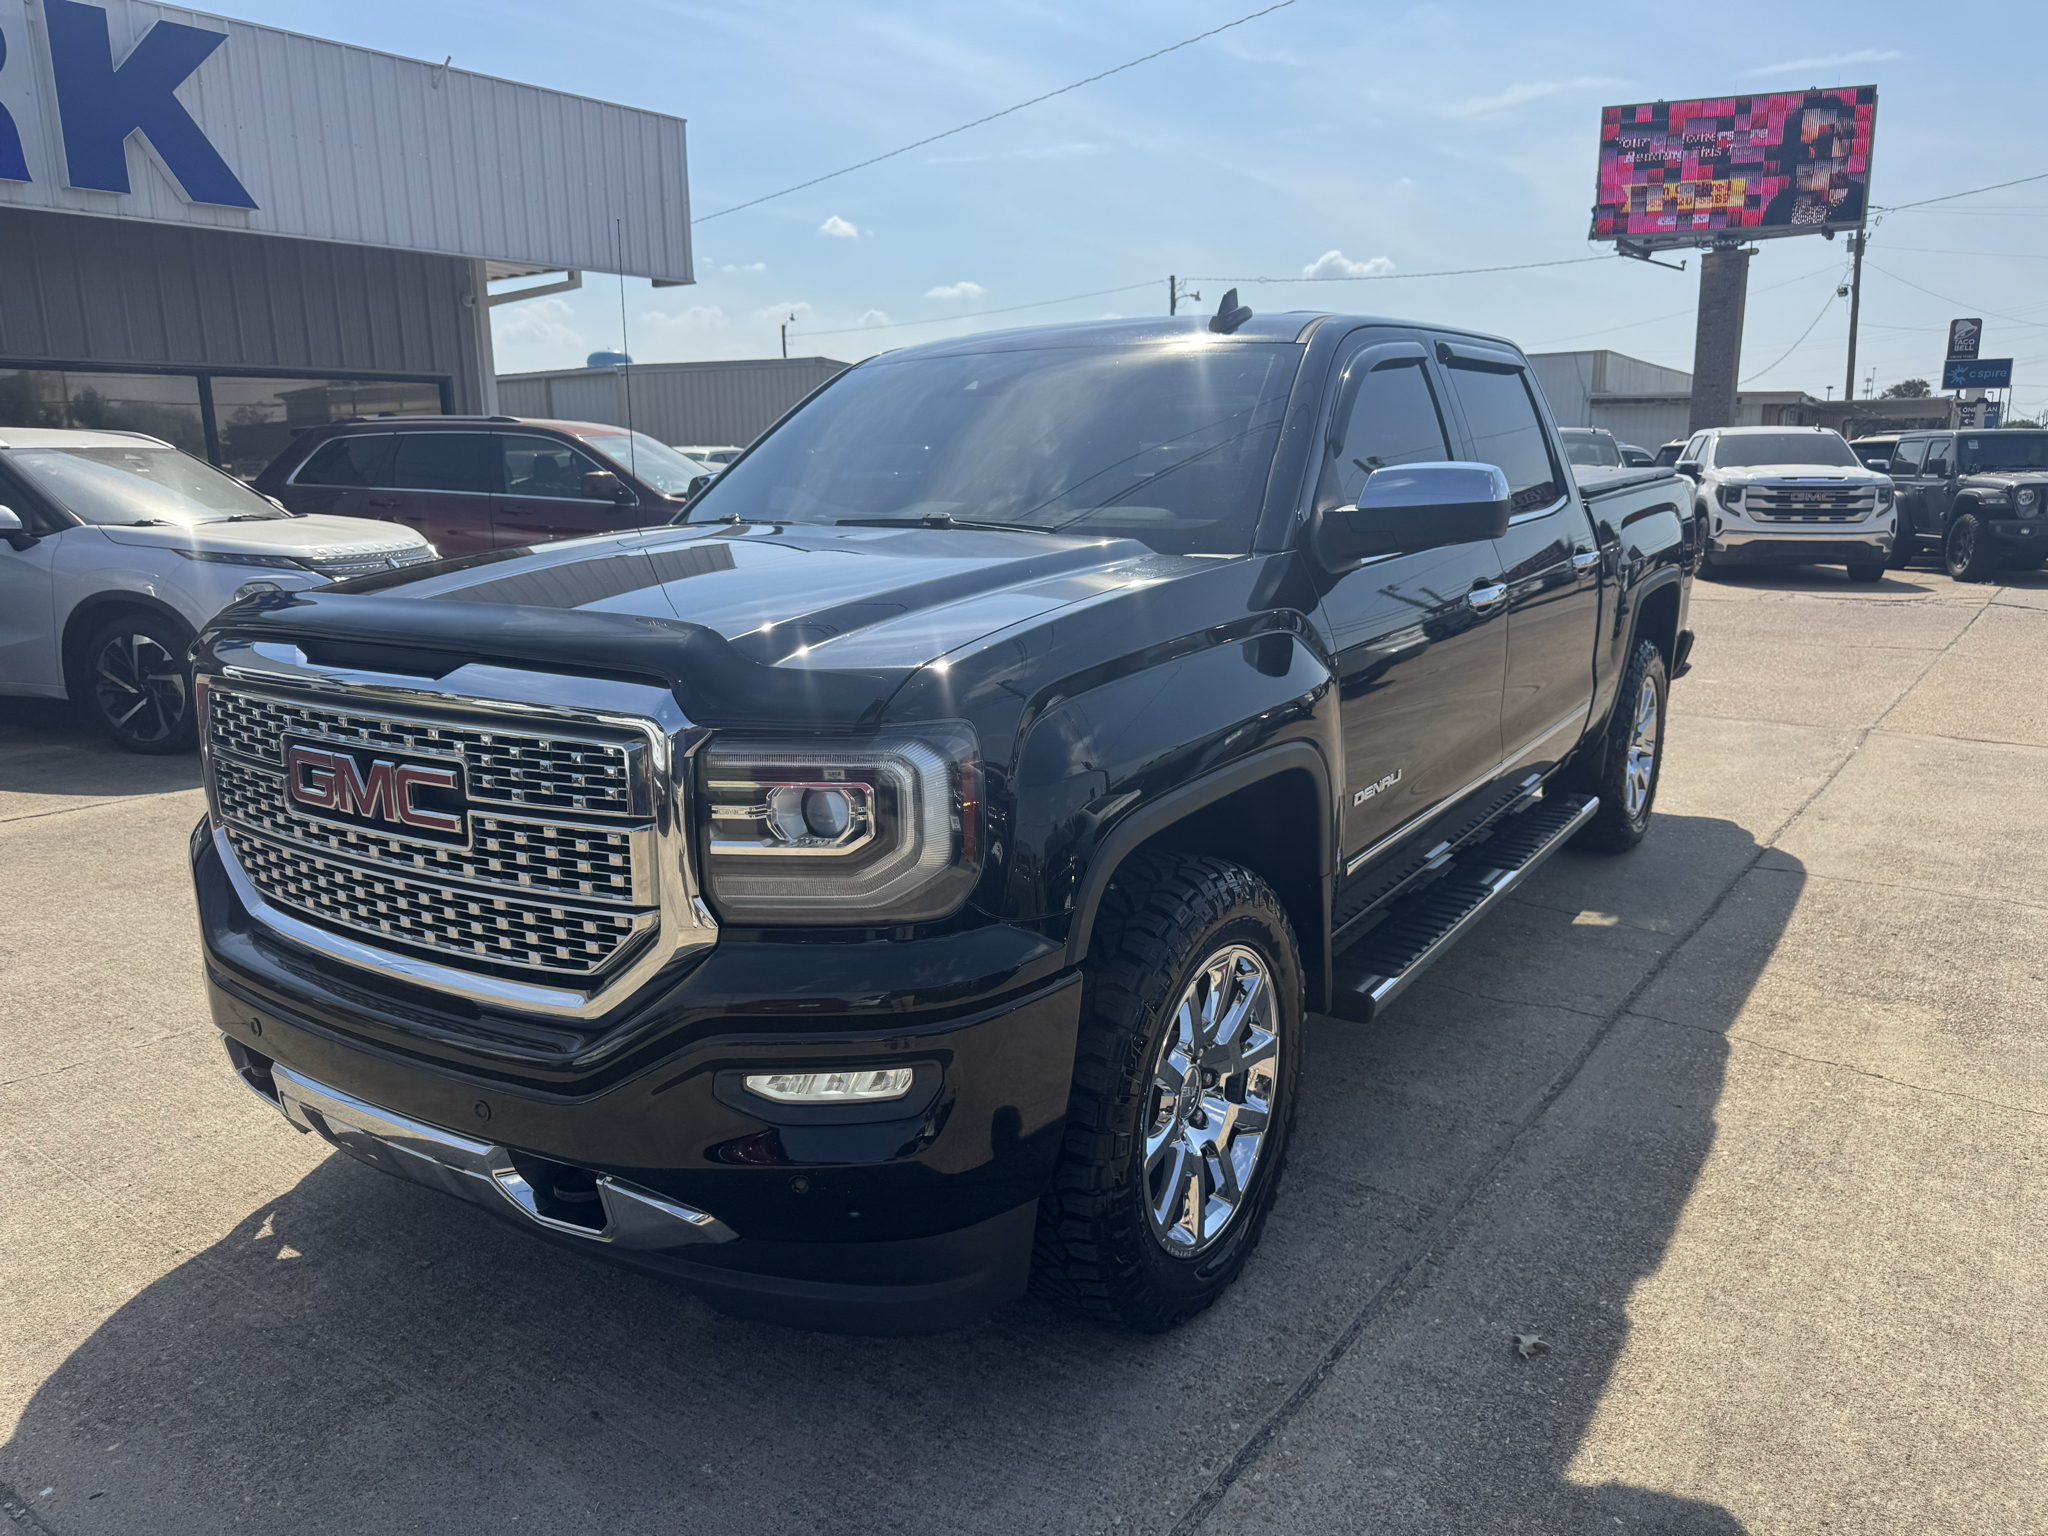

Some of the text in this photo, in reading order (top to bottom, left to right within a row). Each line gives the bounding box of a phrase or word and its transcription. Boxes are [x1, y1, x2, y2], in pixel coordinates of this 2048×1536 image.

[1697, 240, 1743, 248] LAMAR
[1790, 492, 1836, 501] GMC
[288, 744, 463, 834] GMC
[1353, 768, 1402, 807] DENALI
